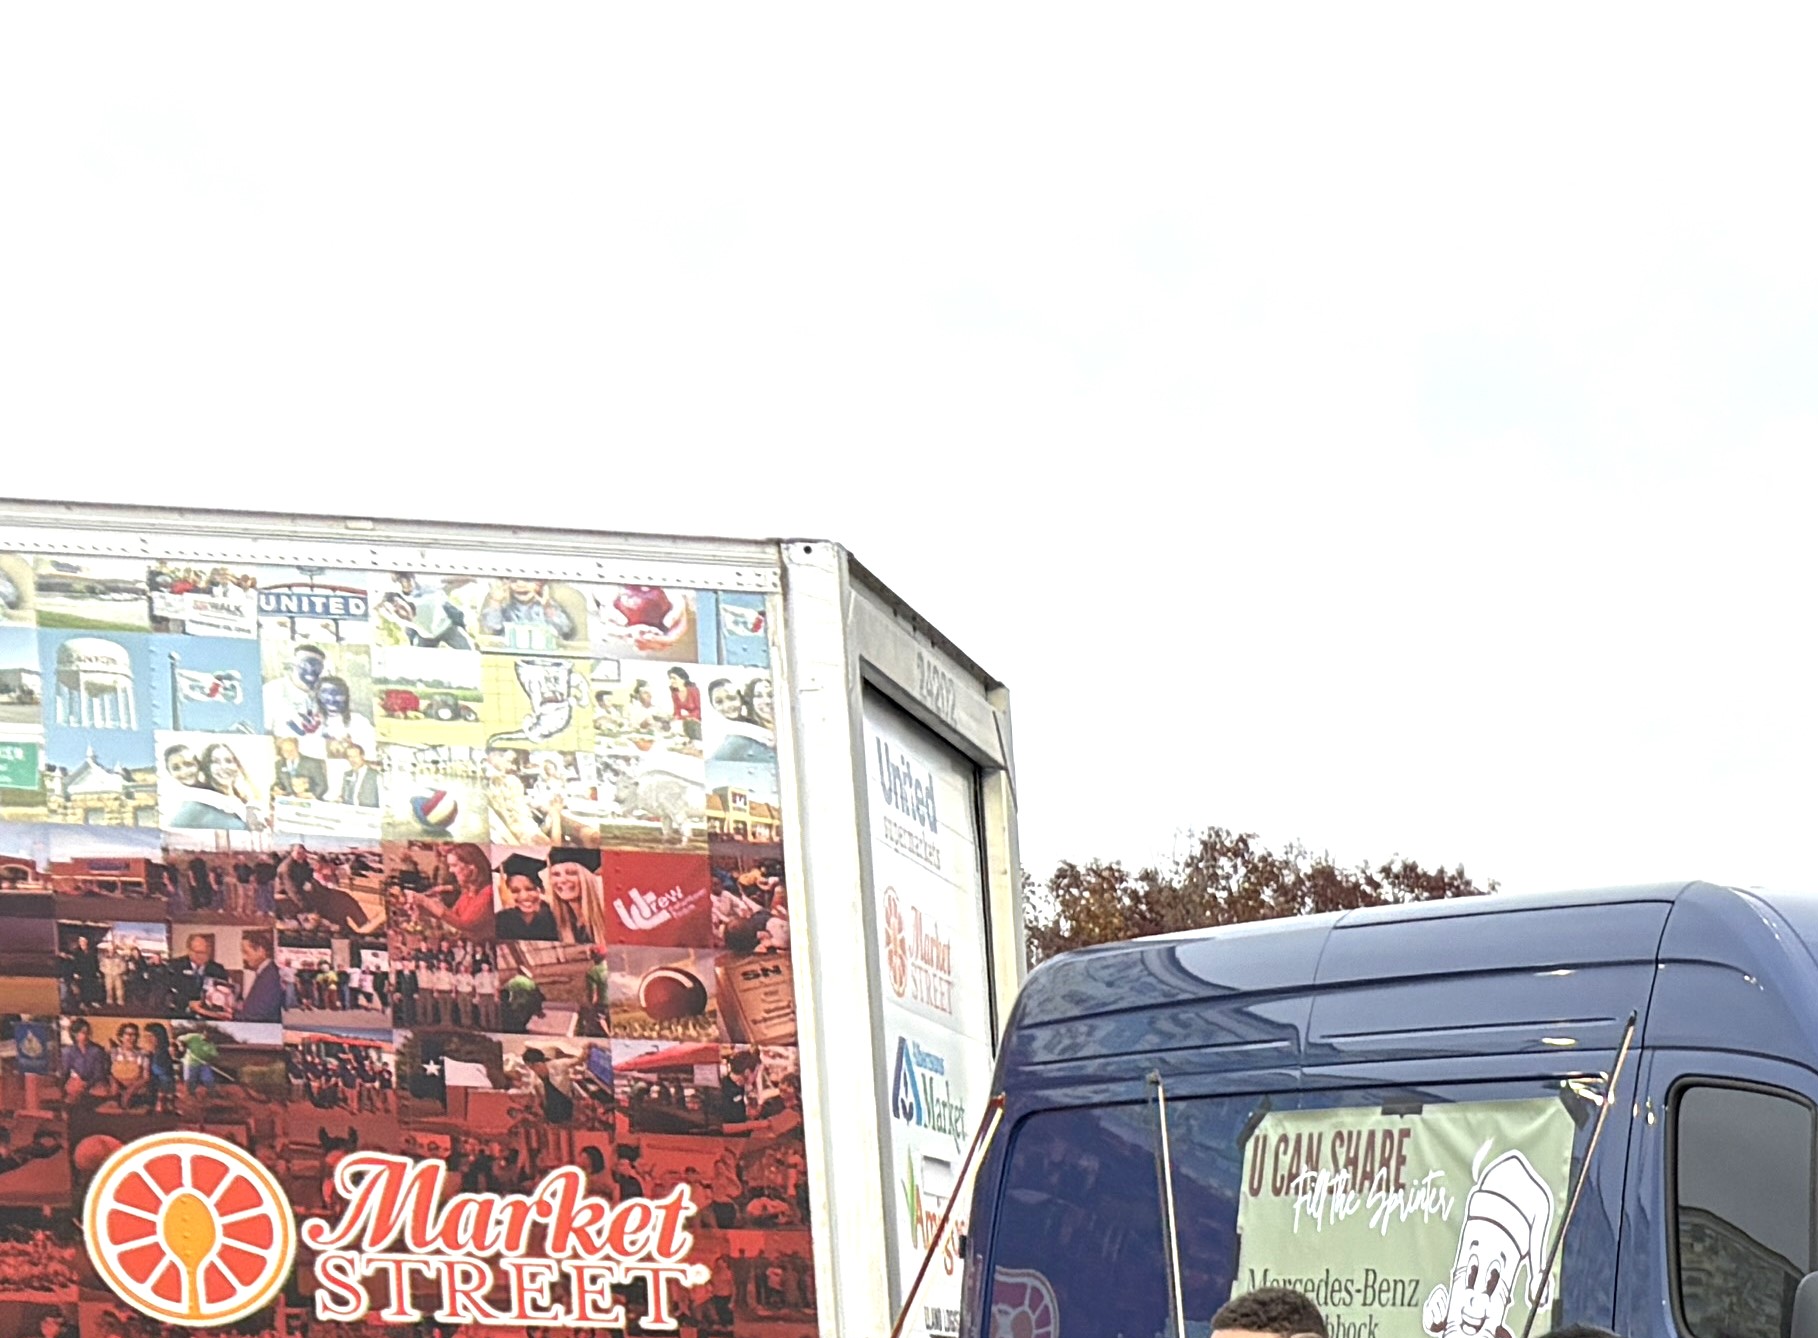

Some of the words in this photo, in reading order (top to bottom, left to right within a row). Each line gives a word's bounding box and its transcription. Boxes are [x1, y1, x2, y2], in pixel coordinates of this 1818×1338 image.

[257, 591, 367, 616] UNITED
[875, 736, 938, 835] United
[921, 1072, 967, 1156] Market
[1249, 1133, 1268, 1198] U
[1271, 1131, 1323, 1197] CAN
[1328, 1127, 1411, 1197] SHARE
[1290, 1163, 1330, 1234] Fill
[1328, 1167, 1362, 1226] the
[1365, 1166, 1455, 1237] Sprinter
[304, 1152, 697, 1263] Market
[314, 1251, 697, 1330] STREET
